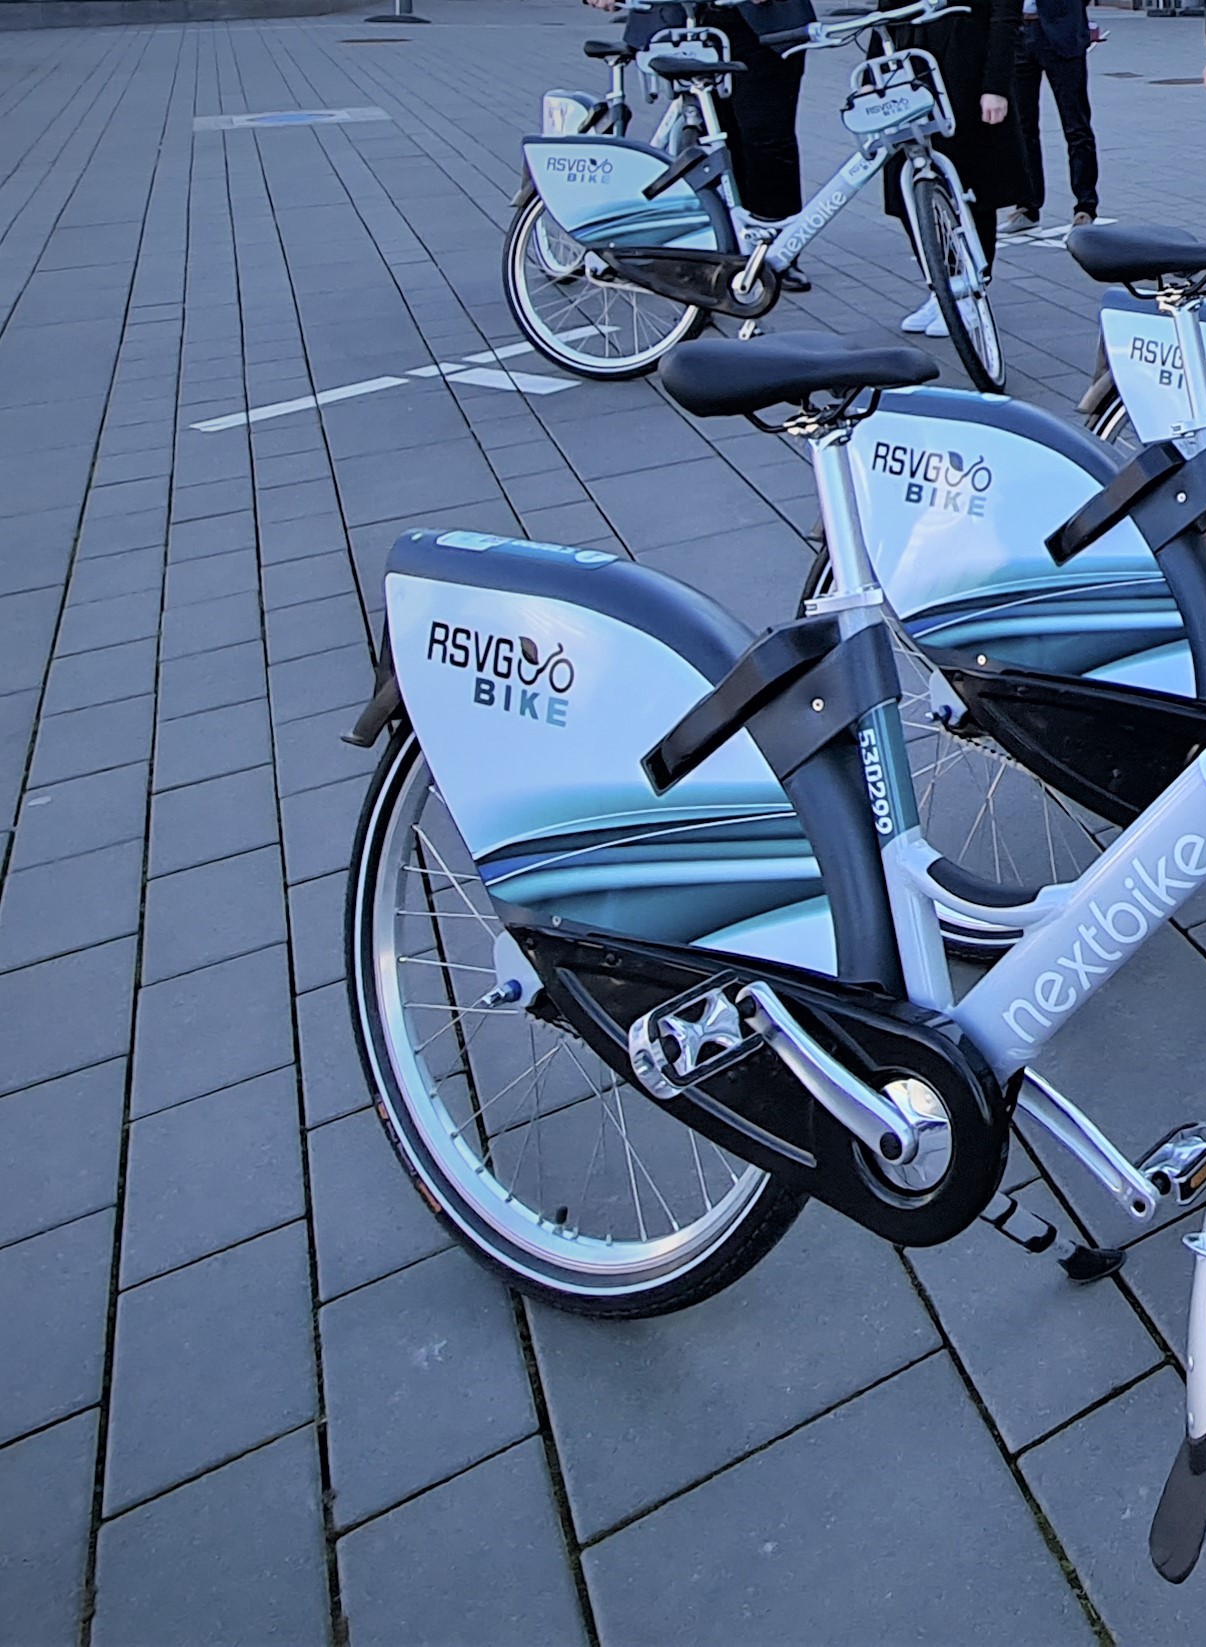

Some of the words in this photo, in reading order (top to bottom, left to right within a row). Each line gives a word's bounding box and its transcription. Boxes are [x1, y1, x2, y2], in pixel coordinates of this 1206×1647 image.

[546, 157, 587, 173] RSVG
[567, 172, 610, 185] BIKE
[776, 191, 847, 264] nextbike
[871, 440, 944, 484] RSVG
[905, 482, 987, 517] BIKE
[426, 620, 514, 680] RSVG
[473, 676, 569, 728] BIKE
[858, 728, 894, 835] 530299
